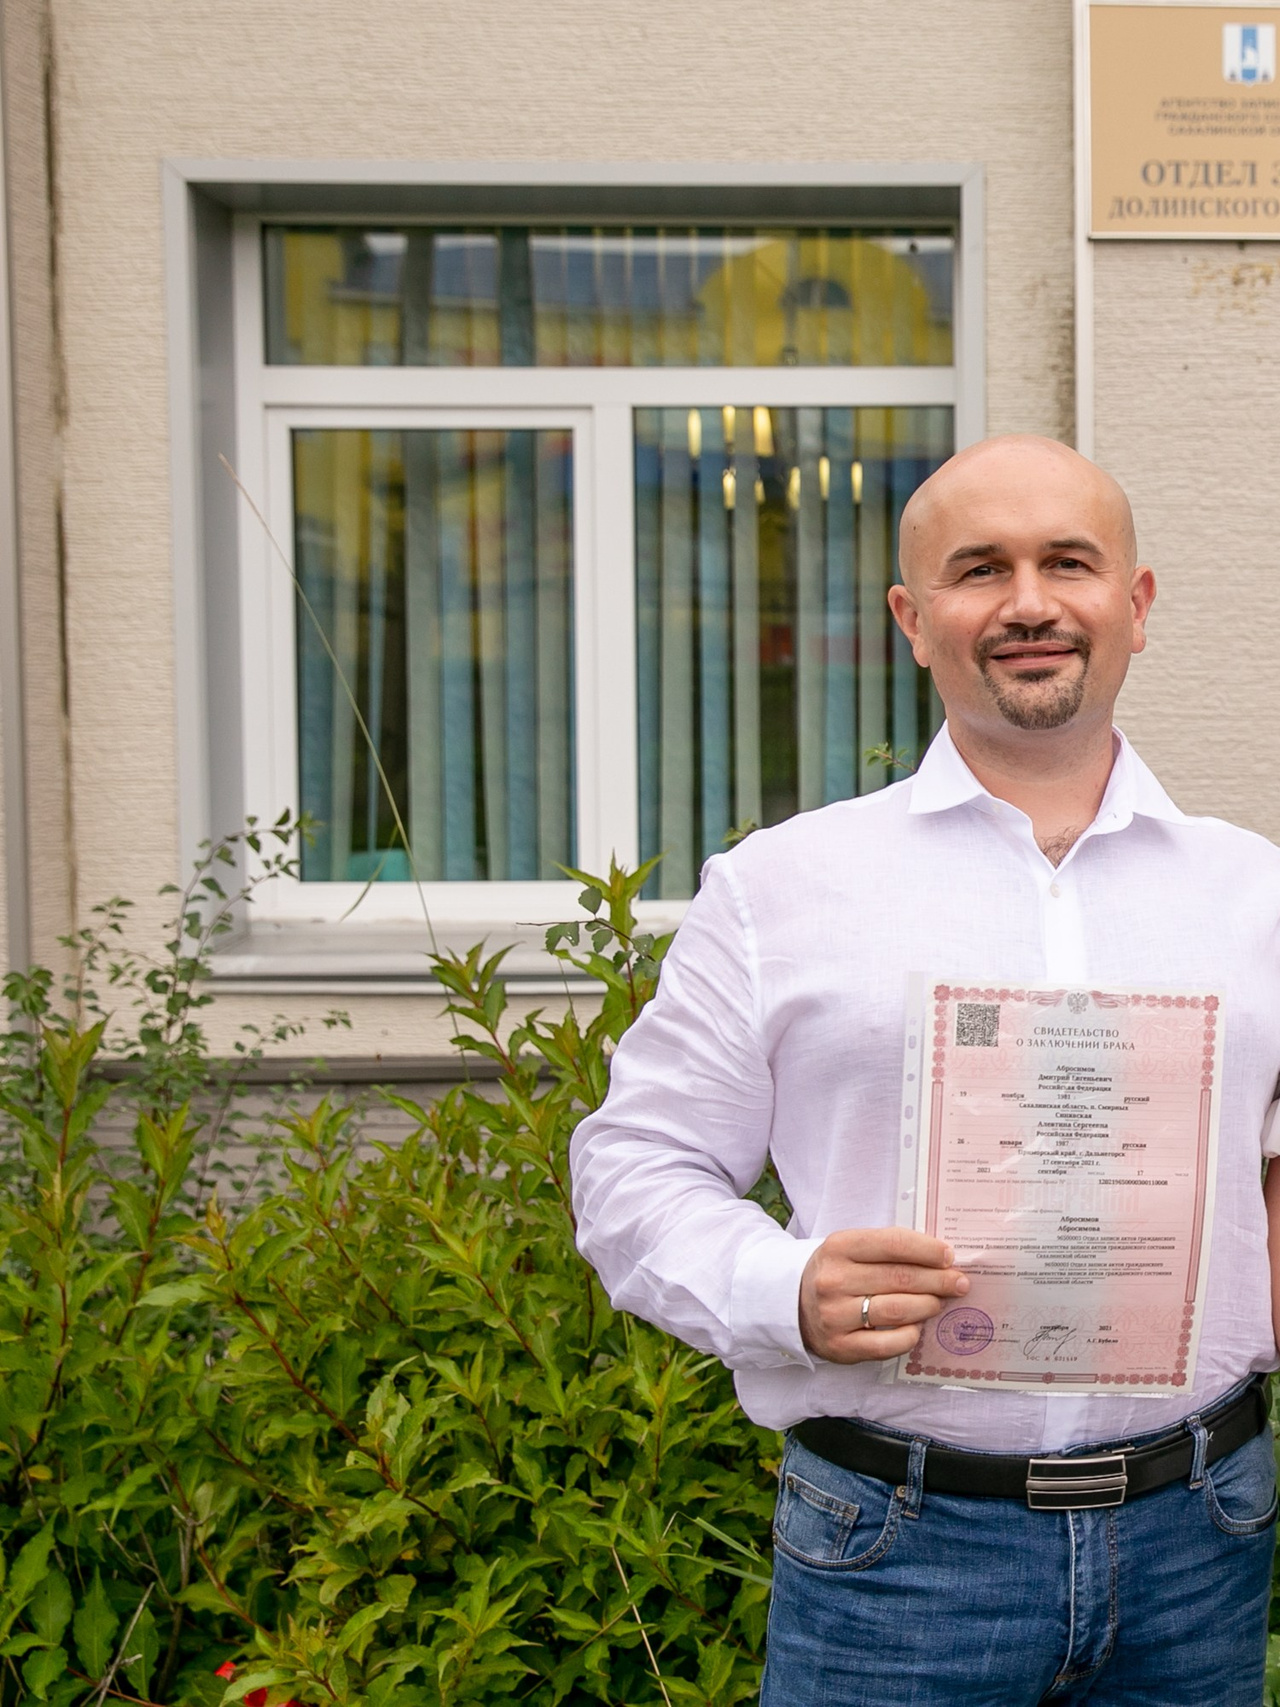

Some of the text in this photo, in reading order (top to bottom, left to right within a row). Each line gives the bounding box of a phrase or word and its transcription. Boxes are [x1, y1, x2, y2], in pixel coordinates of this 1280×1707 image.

[1140, 158, 1258, 190] ОТДЕЛ
[1108, 196, 1280, 221] ДОЛИНСКОГО
[1033, 1026, 1120, 1038] СВИДЕТЕЛЬСТВО
[1016, 1038, 1136, 1051] О ЗАКЛЮЧЕНИИ БРАКА
[1056, 1064, 1096, 1074] Абросимов
[1038, 1074, 1070, 1083] Дмитрий
[1076, 1084, 1112, 1093] Федерация
